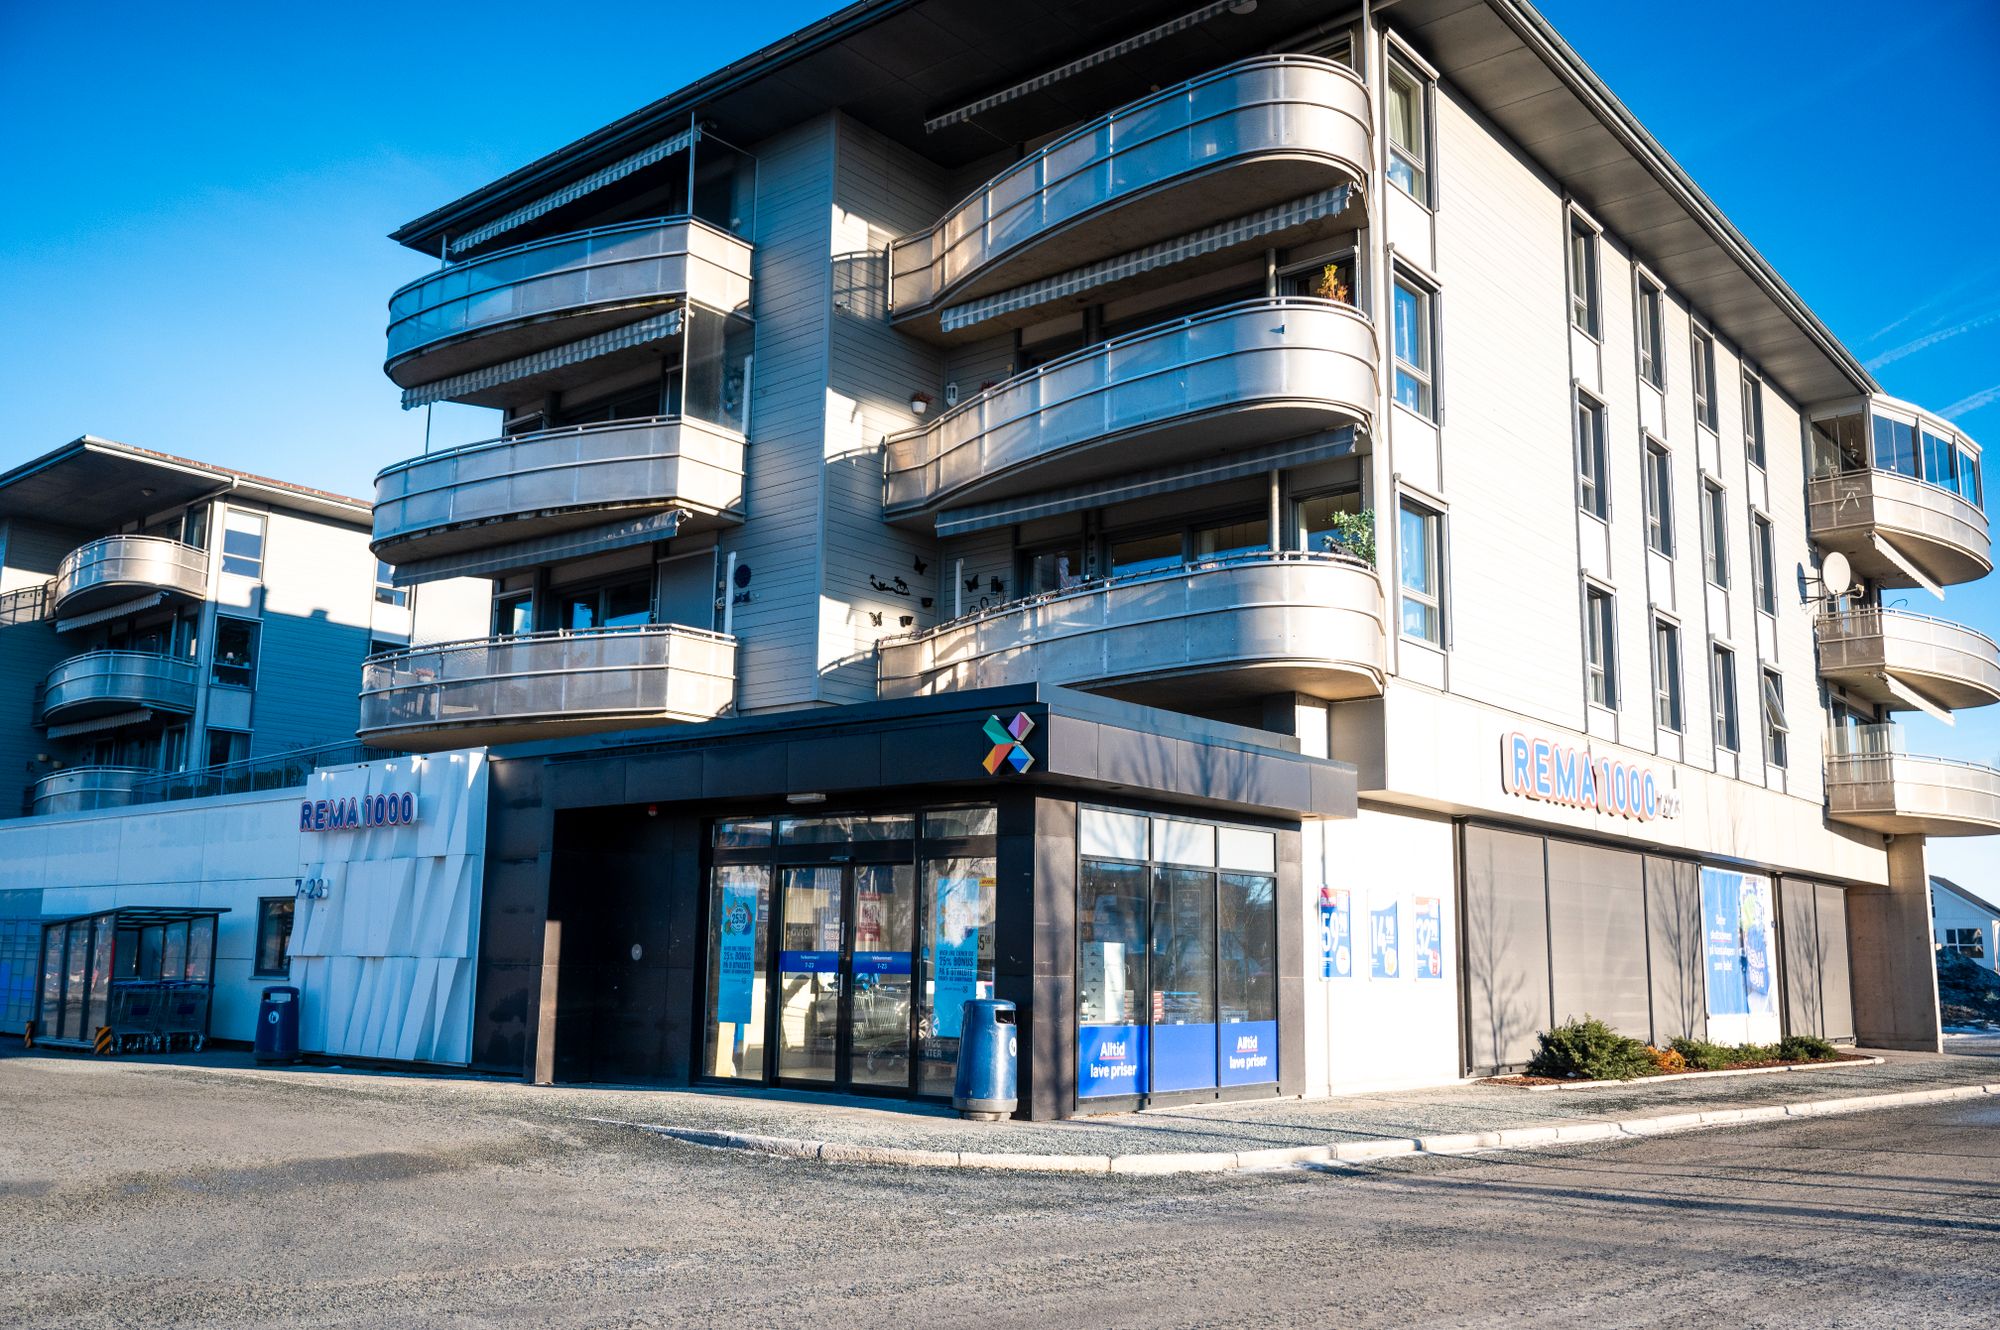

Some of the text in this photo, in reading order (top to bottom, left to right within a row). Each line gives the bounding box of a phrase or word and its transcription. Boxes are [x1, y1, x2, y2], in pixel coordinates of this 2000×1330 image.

[1511, 731, 1655, 820] REMA 1000
[300, 791, 413, 832] REMA 1000
[295, 878, 324, 899] 7-23
[1320, 912, 1339, 952] 59
[1371, 915, 1386, 955] 14
[1415, 918, 1431, 955] 32
[953, 956, 974, 967] BONUS
[1100, 1041, 1126, 1057] Alltid
[1236, 1035, 1258, 1050] Alltid
[1090, 1062, 1137, 1080] lave priser
[1229, 1054, 1268, 1069] lave priser
